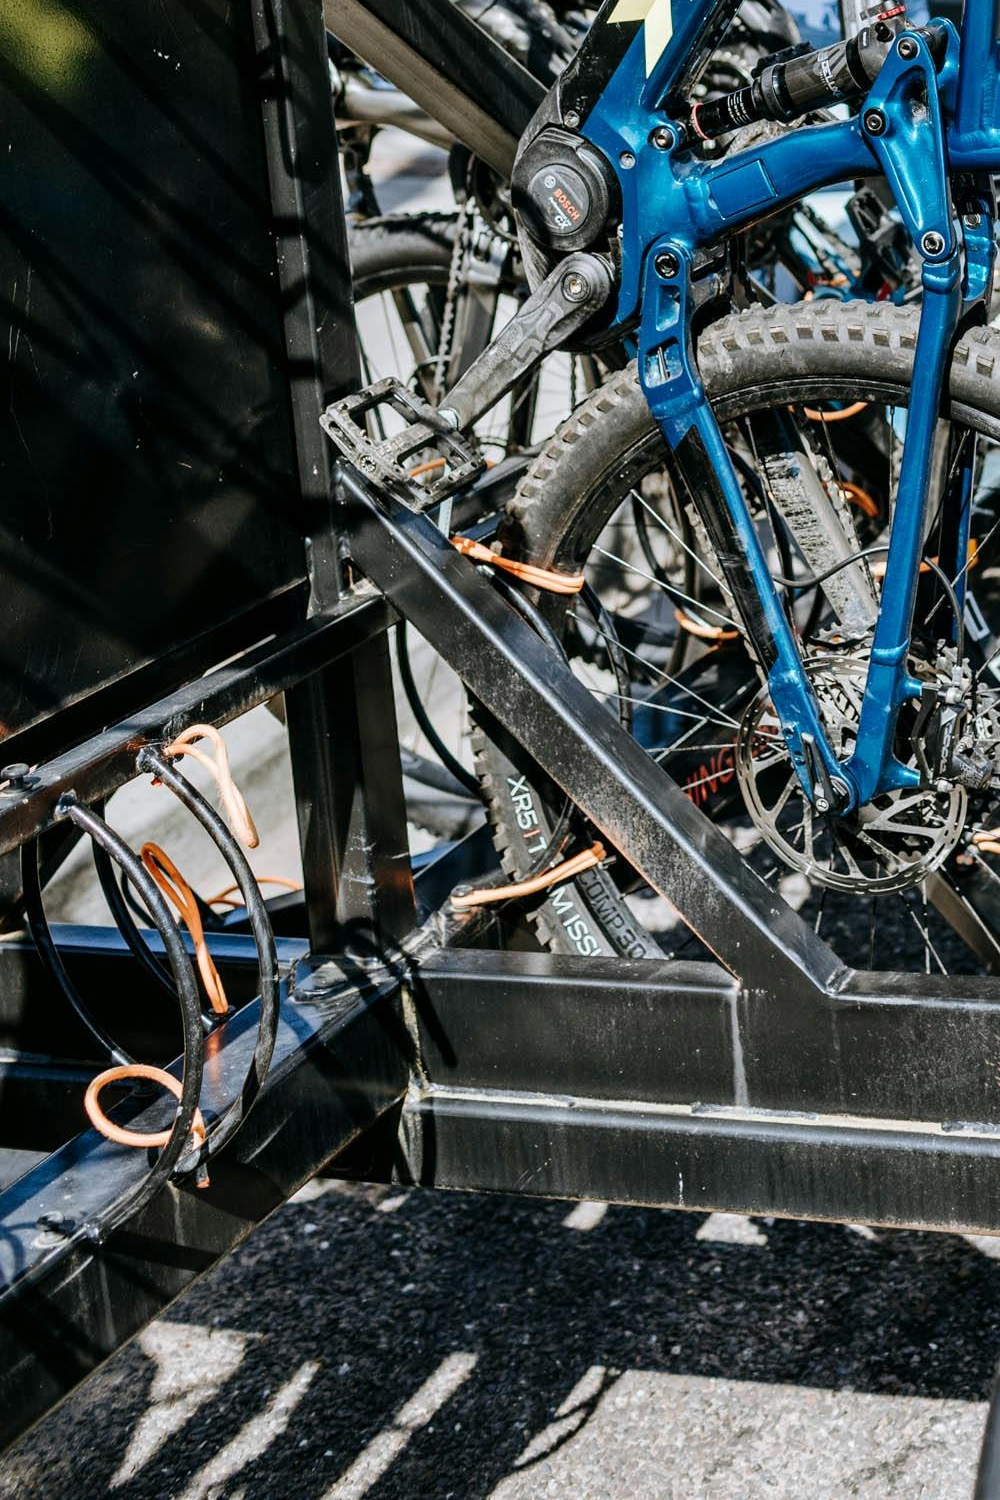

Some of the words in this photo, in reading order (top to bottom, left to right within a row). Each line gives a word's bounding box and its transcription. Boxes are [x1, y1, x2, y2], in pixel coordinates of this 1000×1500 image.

[553, 188, 581, 222] BOSCH
[507, 775, 539, 830] XR5
[578, 869, 625, 930] COMP
